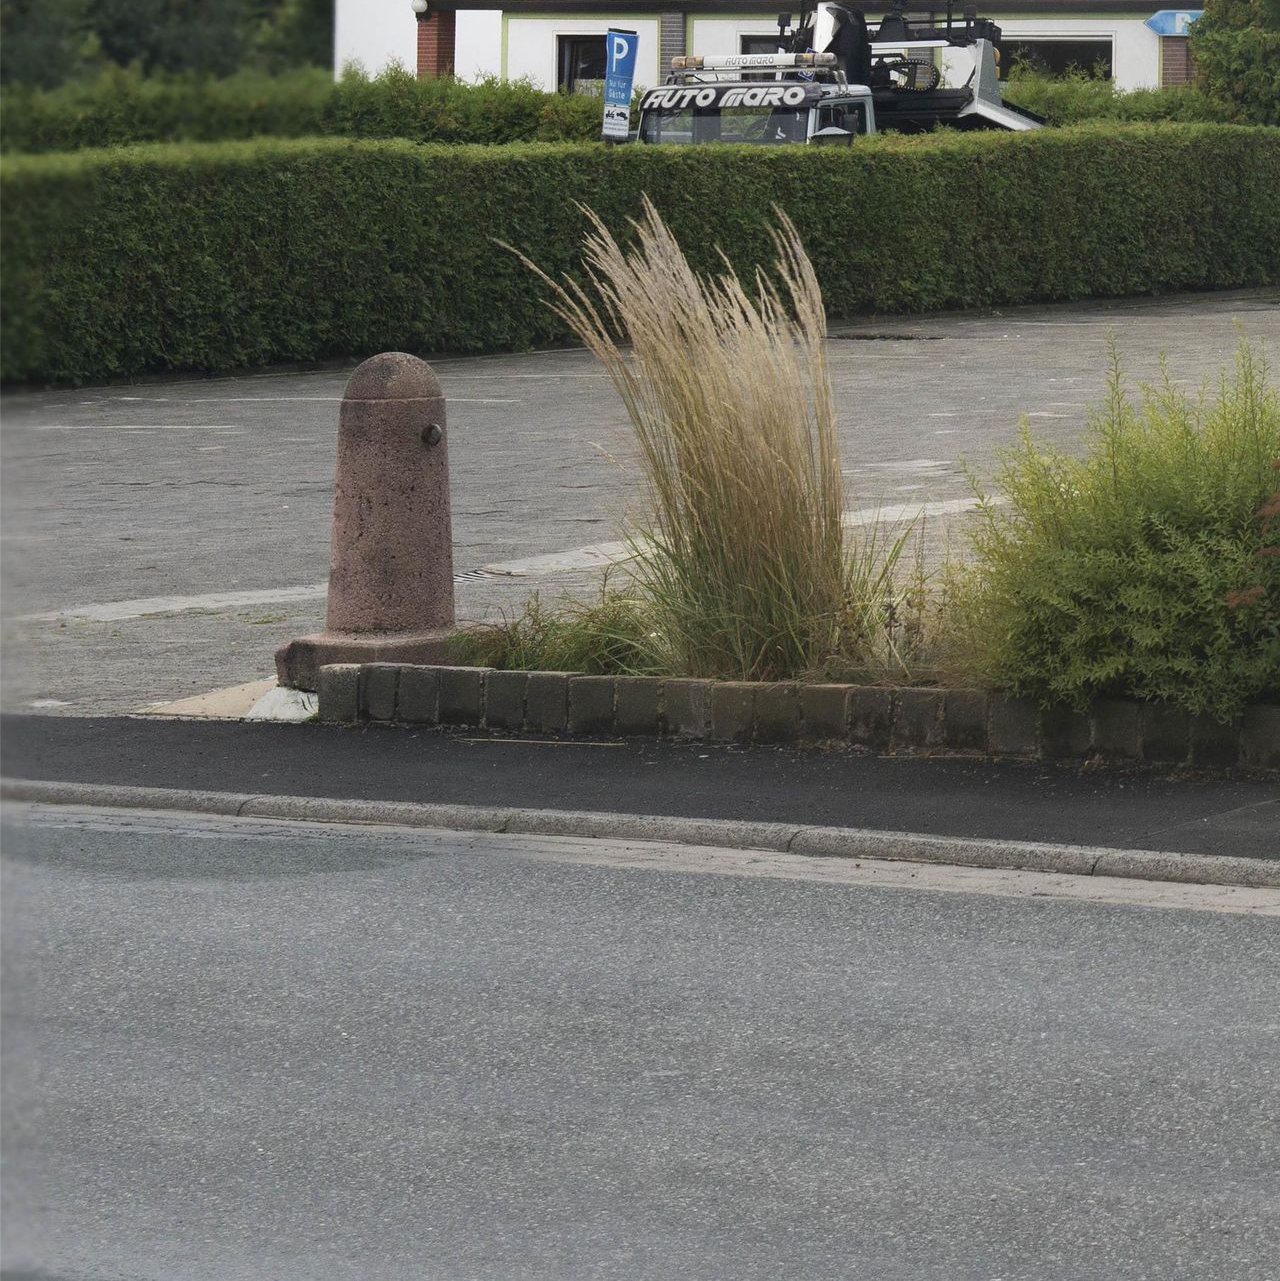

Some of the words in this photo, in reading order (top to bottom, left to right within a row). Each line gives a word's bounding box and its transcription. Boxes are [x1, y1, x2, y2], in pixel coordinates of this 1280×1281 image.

[612, 37, 629, 73] P
[725, 57, 748, 65] AUTO
[643, 87, 716, 109] AUTO
[718, 86, 806, 107] MARO
